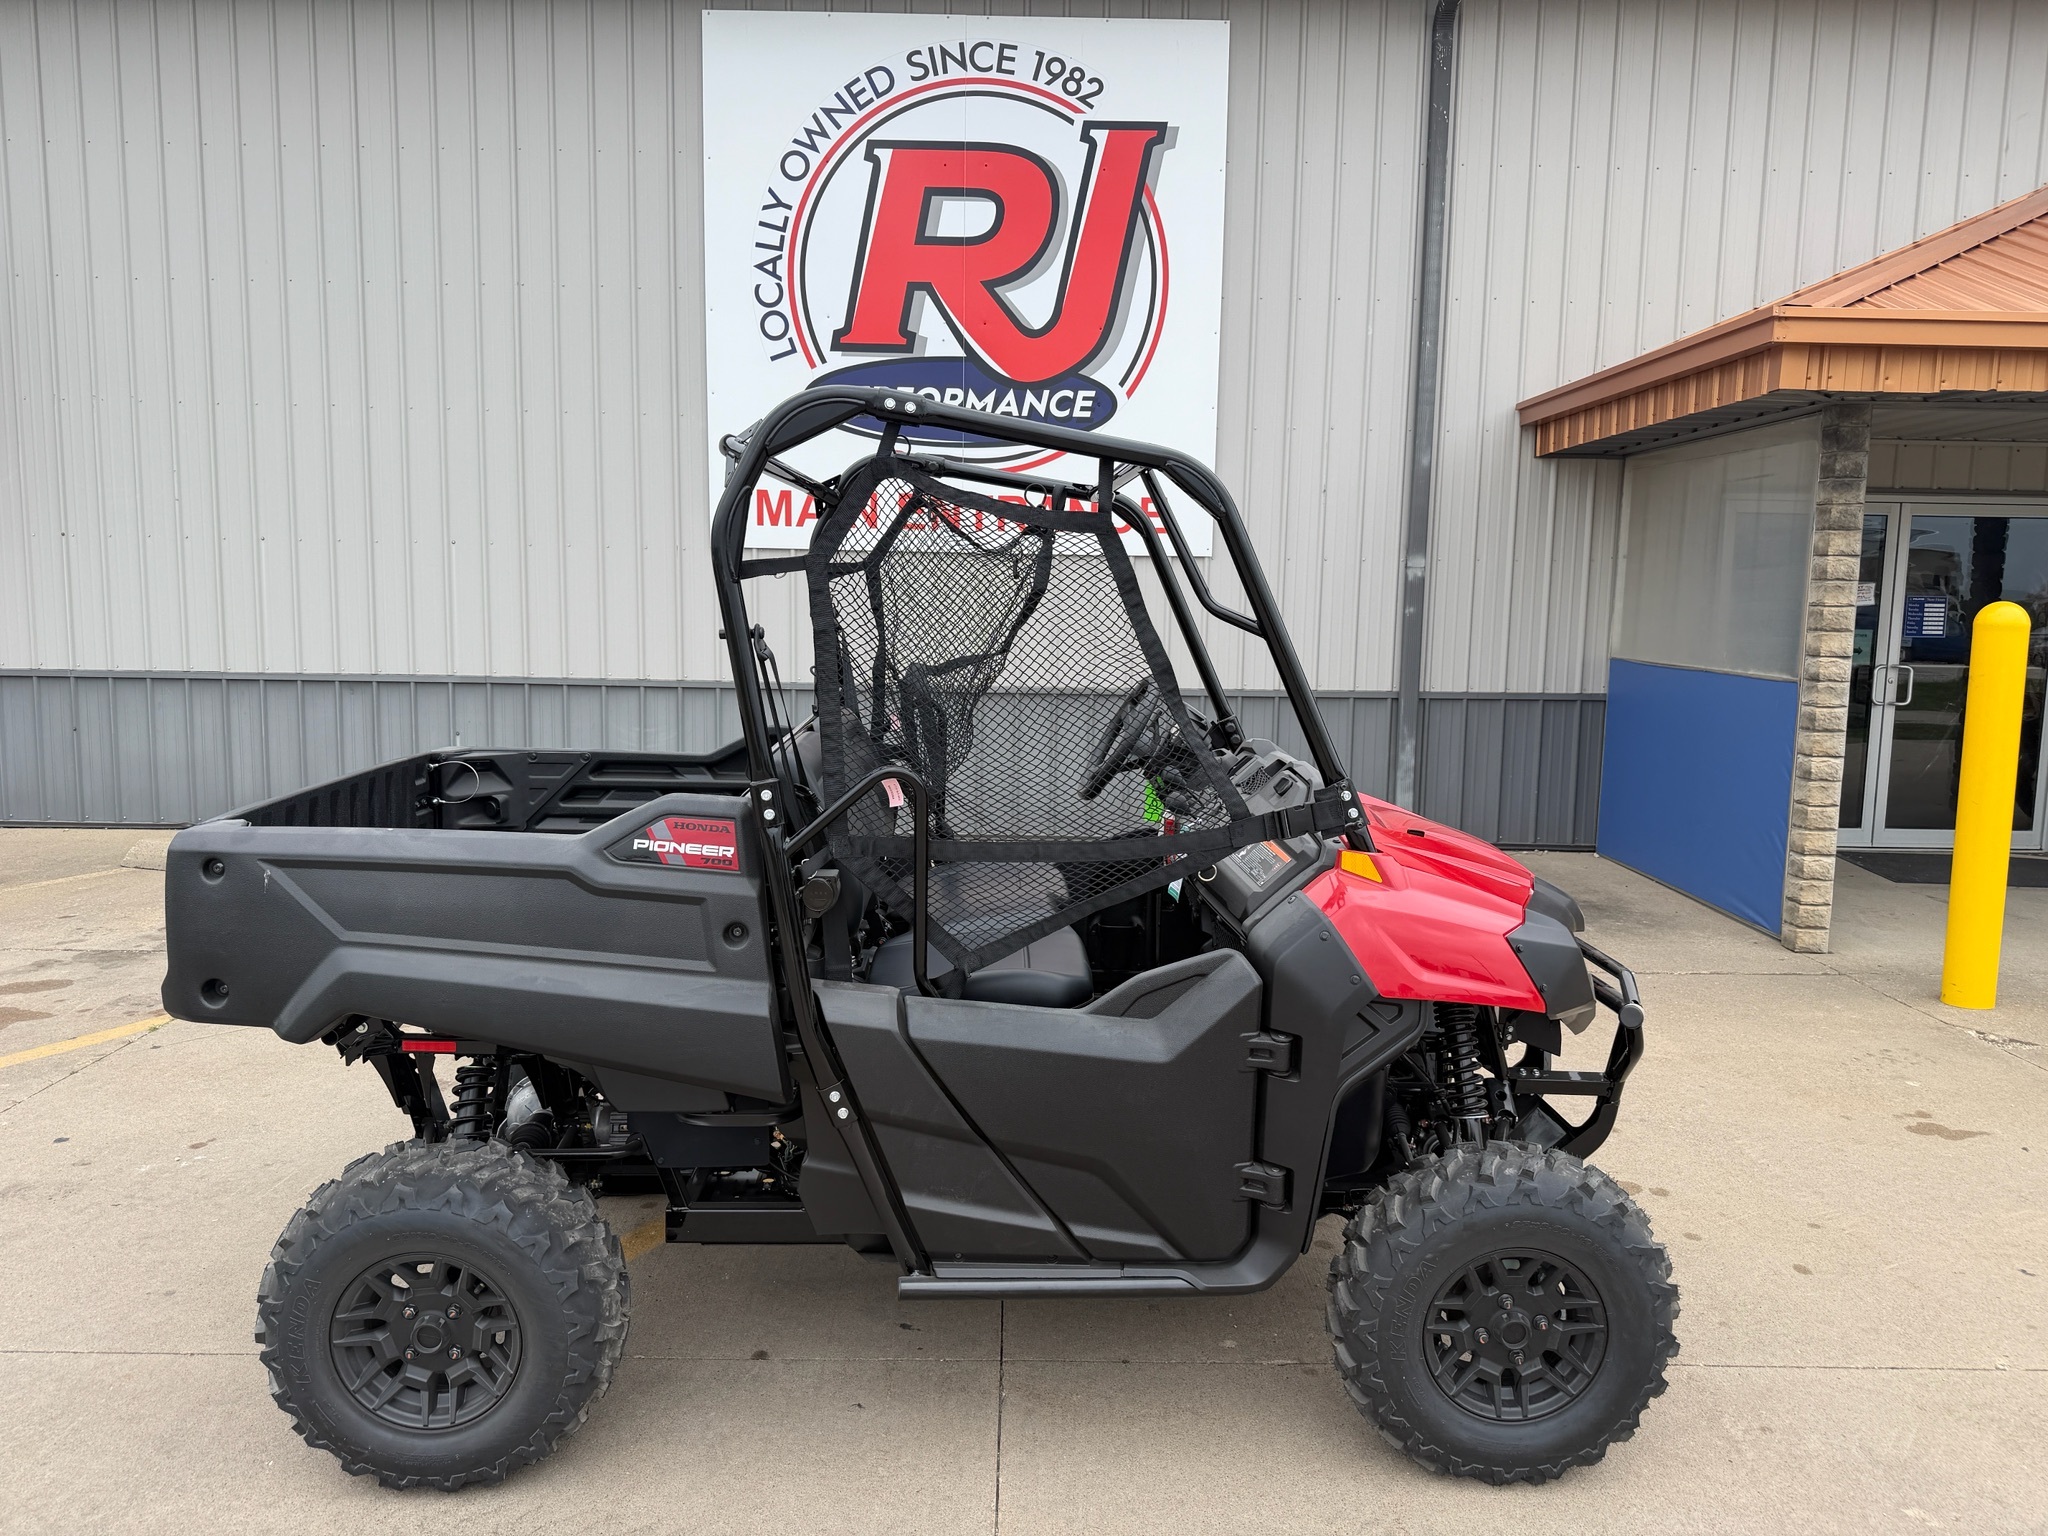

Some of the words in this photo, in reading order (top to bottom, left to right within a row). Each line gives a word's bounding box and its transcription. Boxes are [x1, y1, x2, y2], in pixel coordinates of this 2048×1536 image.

[753, 186, 797, 362] LOCALLY
[780, 65, 896, 182] OWNED
[906, 41, 1018, 82] SINCE
[1032, 50, 1105, 110] 1982
[830, 121, 1169, 384] RJ
[633, 838, 735, 858] PIONEER
[673, 821, 731, 834] HONDA
[701, 857, 733, 866] 700
[287, 1278, 322, 1384] KENDA
[1390, 1260, 1438, 1361] KENDA
